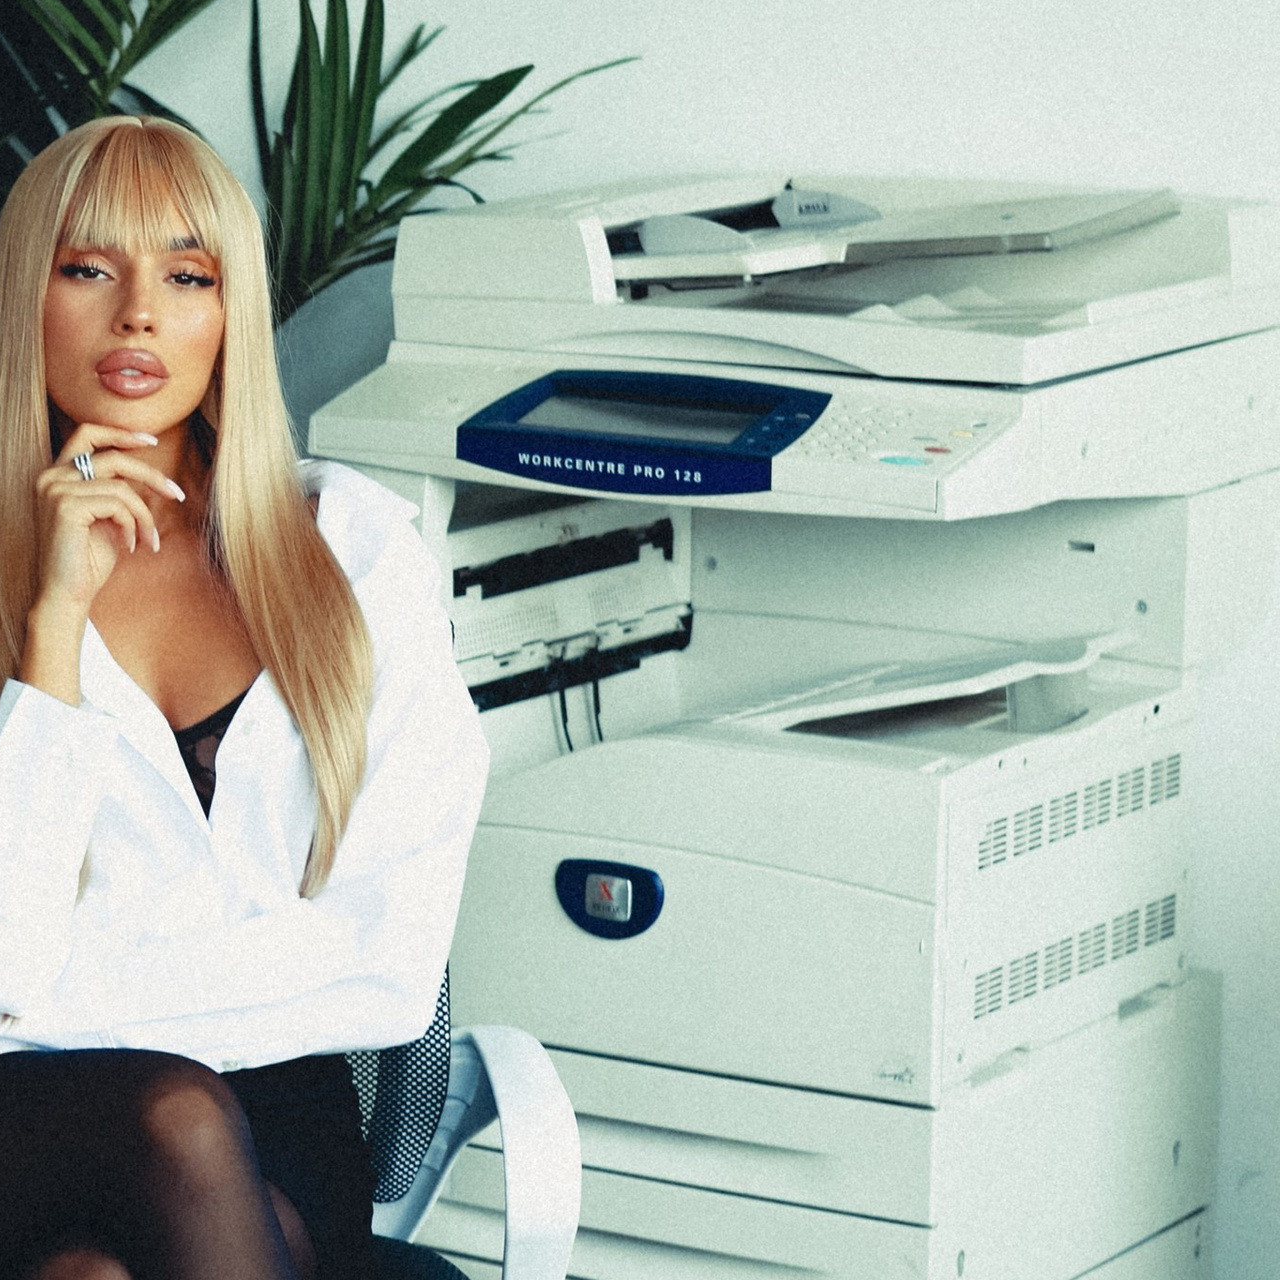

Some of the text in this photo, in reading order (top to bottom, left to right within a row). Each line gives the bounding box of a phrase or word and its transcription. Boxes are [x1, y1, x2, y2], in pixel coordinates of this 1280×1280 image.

[518, 452, 702, 483] WORKCENTRE PRO 128
